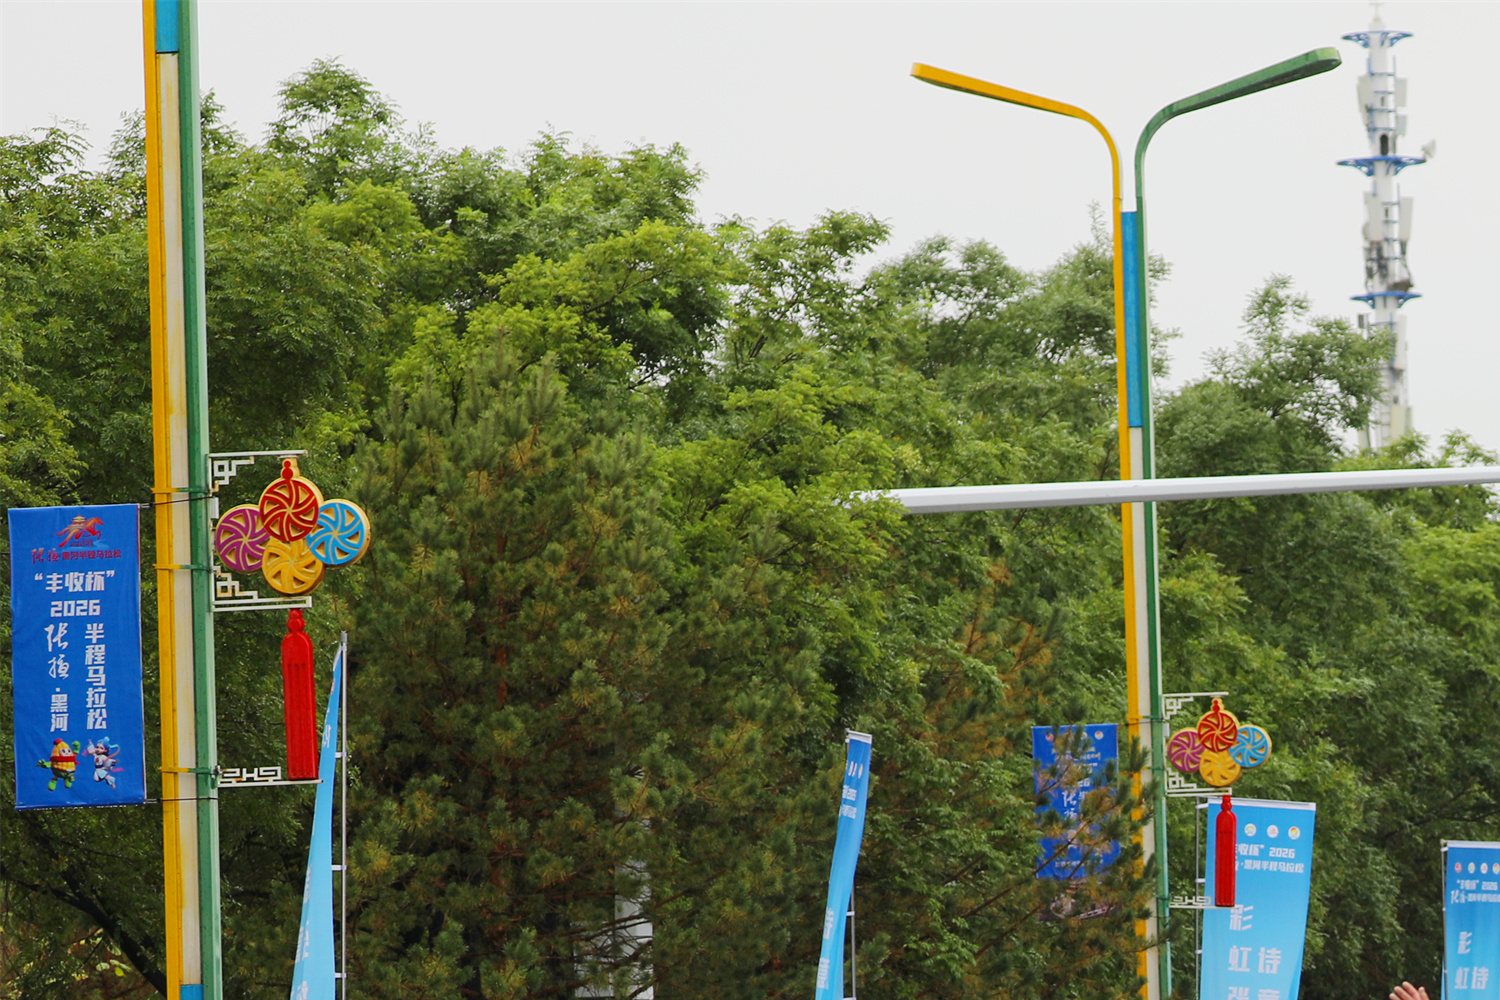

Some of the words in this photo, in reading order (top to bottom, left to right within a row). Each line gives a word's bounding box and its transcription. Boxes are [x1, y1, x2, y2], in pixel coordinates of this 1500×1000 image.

[34, 569, 116, 593] “丰收杯”
[50, 599, 101, 617] 2026
[84, 623, 108, 730] 半程马拉松
[1269, 847, 1297, 859] 2026
